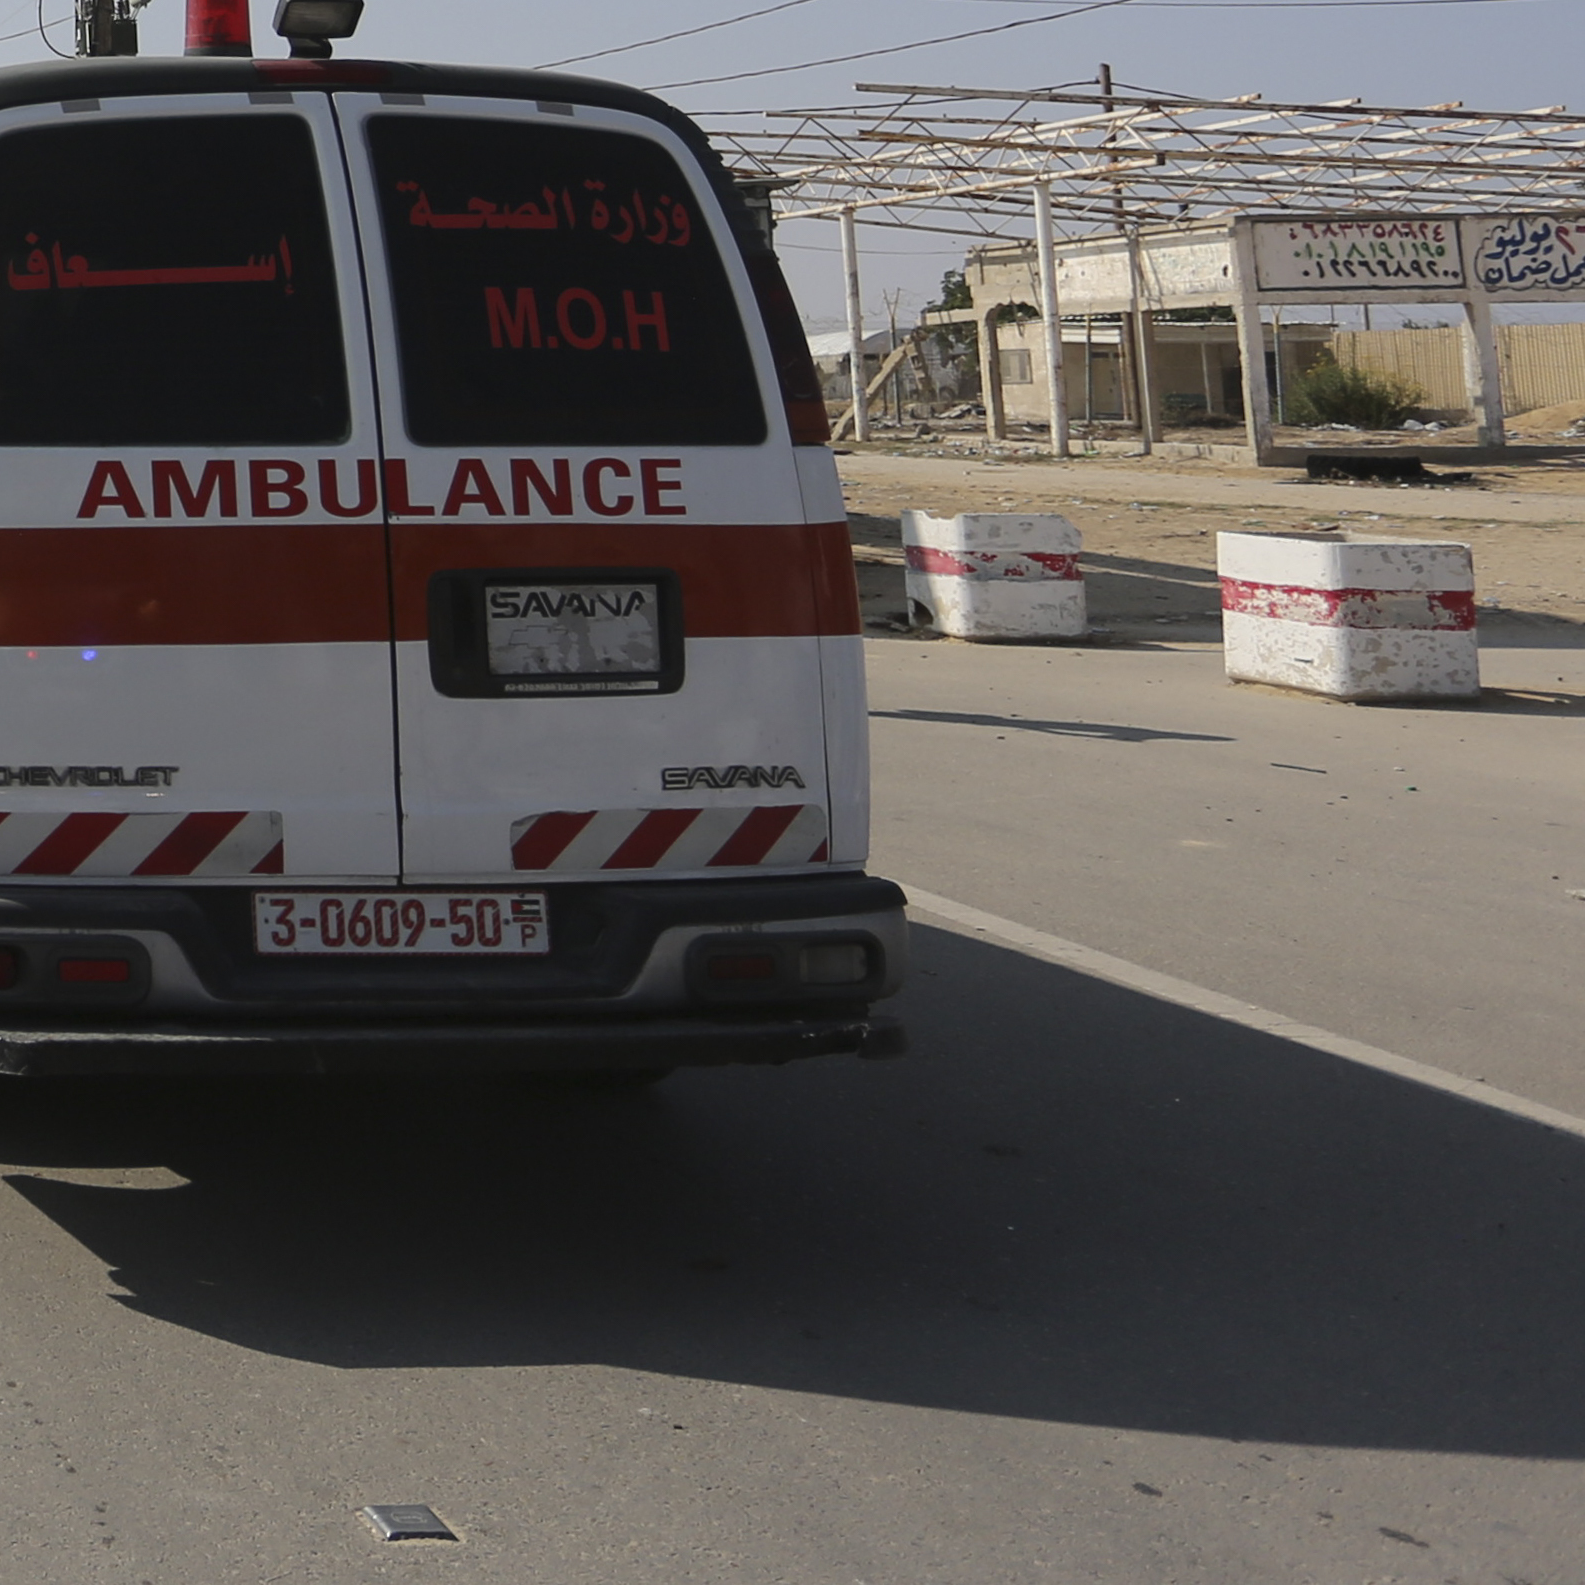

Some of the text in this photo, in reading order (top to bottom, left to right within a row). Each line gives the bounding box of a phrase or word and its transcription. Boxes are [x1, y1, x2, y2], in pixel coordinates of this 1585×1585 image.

[395, 179, 691, 246] وزارة الصحة
[1484, 217, 1554, 260] يوليو
[6, 232, 296, 294] إسعاف
[1484, 256, 1553, 286] ضمان
[483, 286, 671, 353] M.O.H
[76, 456, 688, 520] AMBULANCE
[490, 590, 646, 619] SAVANA
[661, 764, 807, 791] SAVANA
[268, 898, 502, 948] 3-0609-50
[520, 925, 538, 948] P
